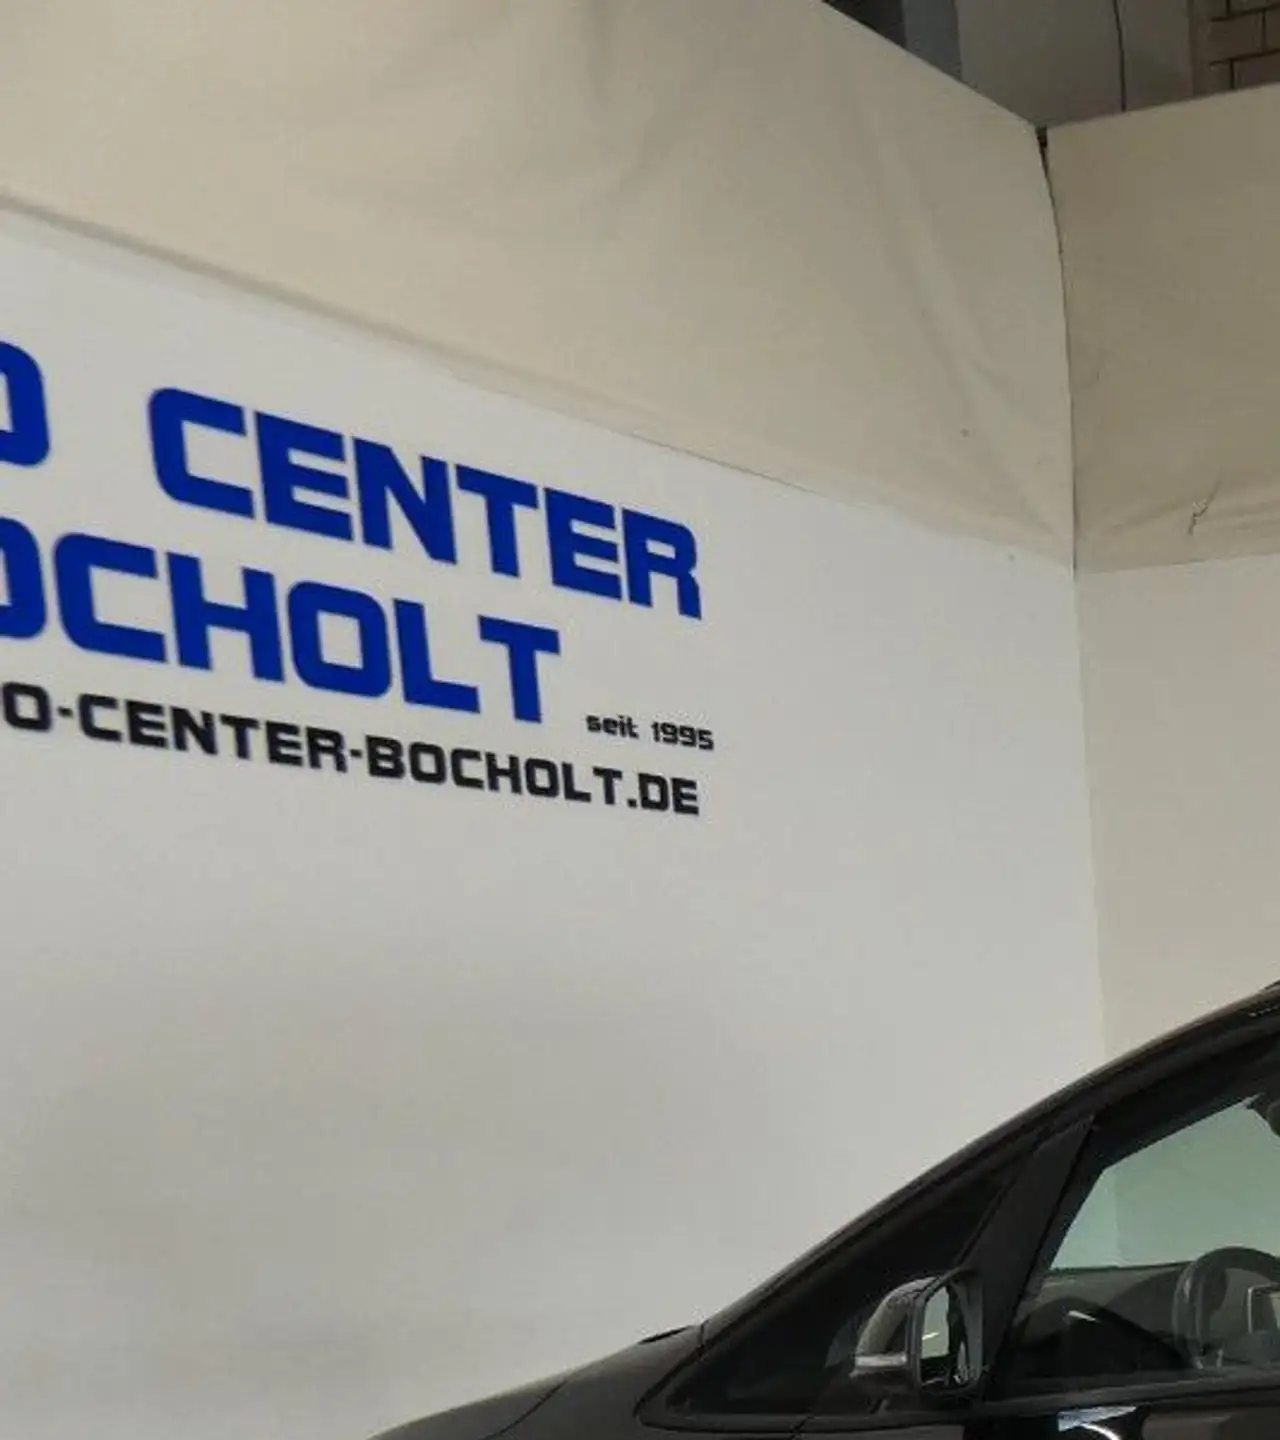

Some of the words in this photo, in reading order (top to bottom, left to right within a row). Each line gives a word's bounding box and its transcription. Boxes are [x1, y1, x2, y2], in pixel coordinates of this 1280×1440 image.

[149, 387, 702, 618] CENTER
[585, 714, 639, 740] seit
[650, 721, 715, 752] 1995
